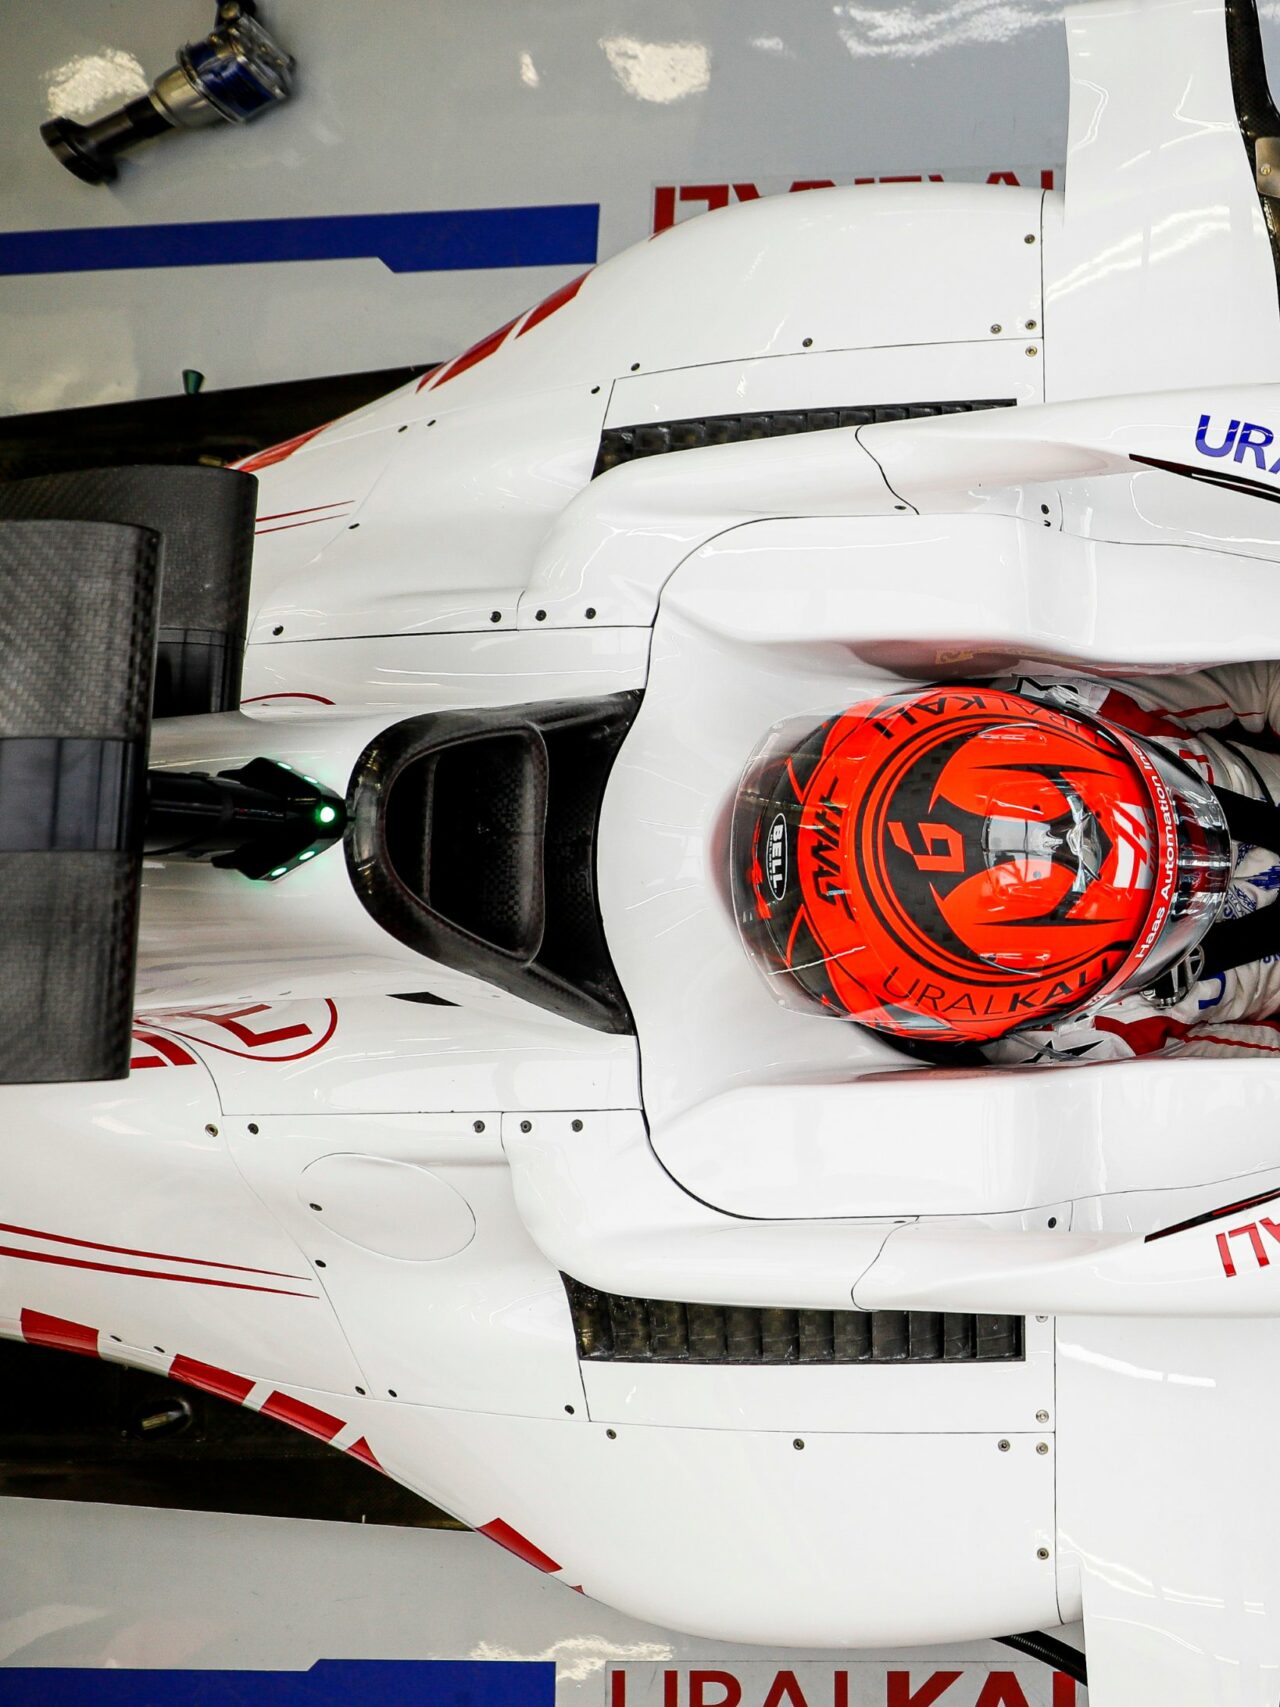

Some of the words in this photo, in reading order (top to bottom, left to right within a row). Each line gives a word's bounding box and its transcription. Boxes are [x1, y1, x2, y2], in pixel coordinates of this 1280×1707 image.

[771, 824, 784, 890] BELL
[811, 776, 857, 924] HAAS
[1135, 906, 1165, 959] Haas
[1151, 774, 1176, 901] Automation
[881, 957, 1111, 1016] URALKALI
